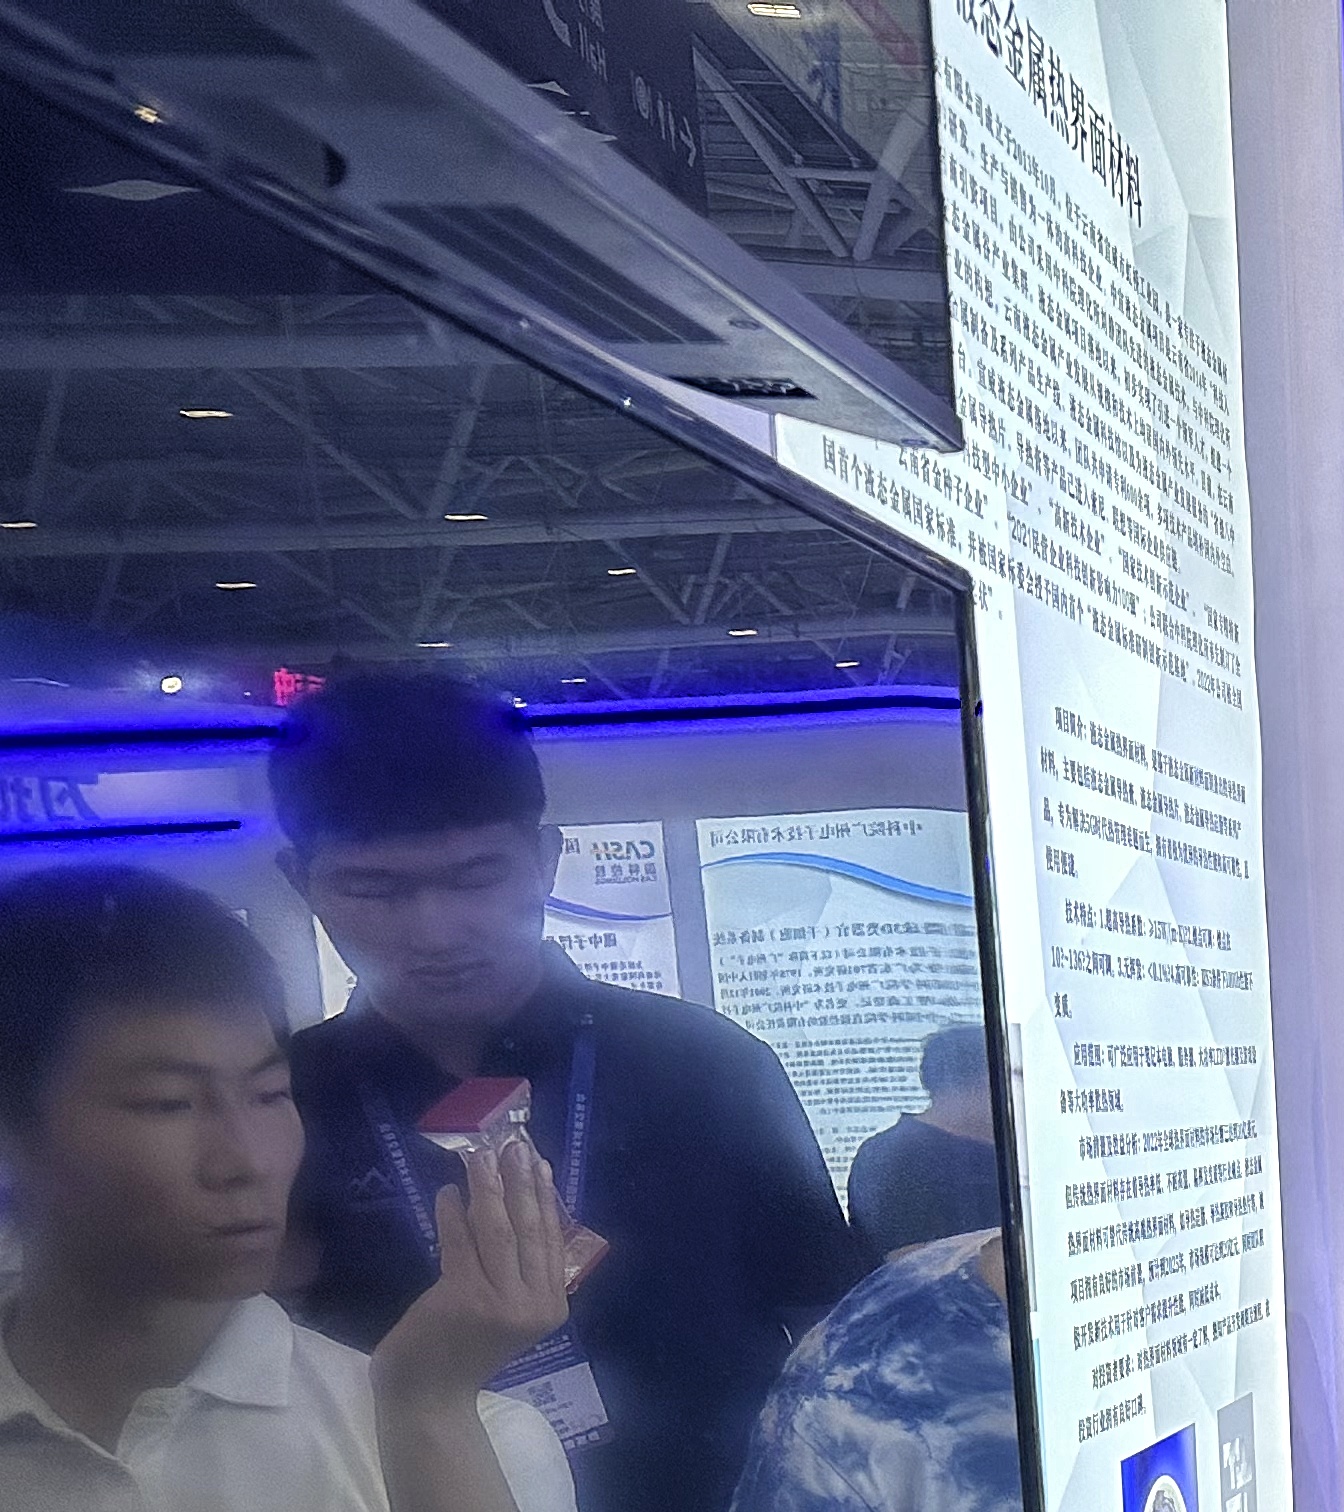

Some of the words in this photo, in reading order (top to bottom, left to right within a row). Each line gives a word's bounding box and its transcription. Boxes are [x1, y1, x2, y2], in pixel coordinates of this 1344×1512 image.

[956, 0, 1142, 229] 态金属热界面材料
